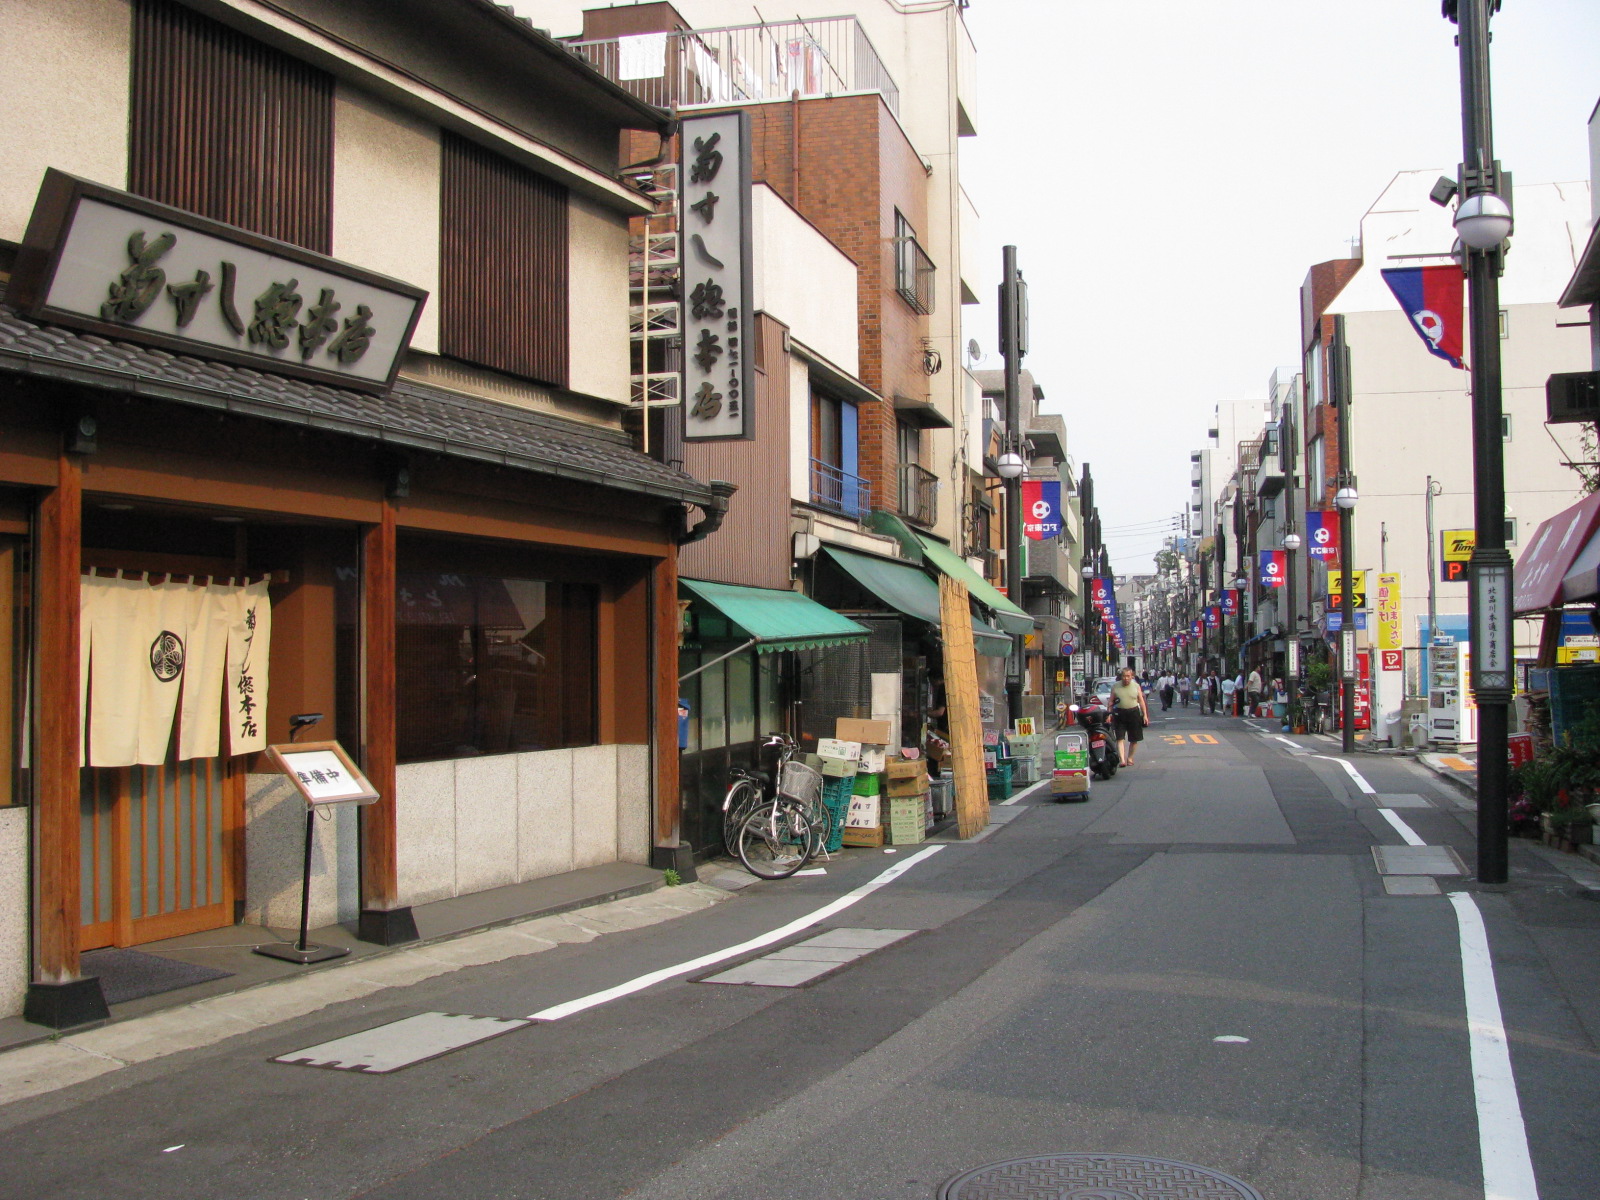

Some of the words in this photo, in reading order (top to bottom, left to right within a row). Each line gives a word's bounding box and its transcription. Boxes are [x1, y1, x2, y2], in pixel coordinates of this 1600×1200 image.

[1451, 540, 1475, 552] Time
[1449, 562, 1462, 580] P
[1332, 595, 1342, 608] P
[1487, 586, 1498, 668] 北品川本通り商店会
[1018, 723, 1032, 735] 100
[1159, 733, 1219, 745] 30
[296, 768, 340, 787] 準備中
